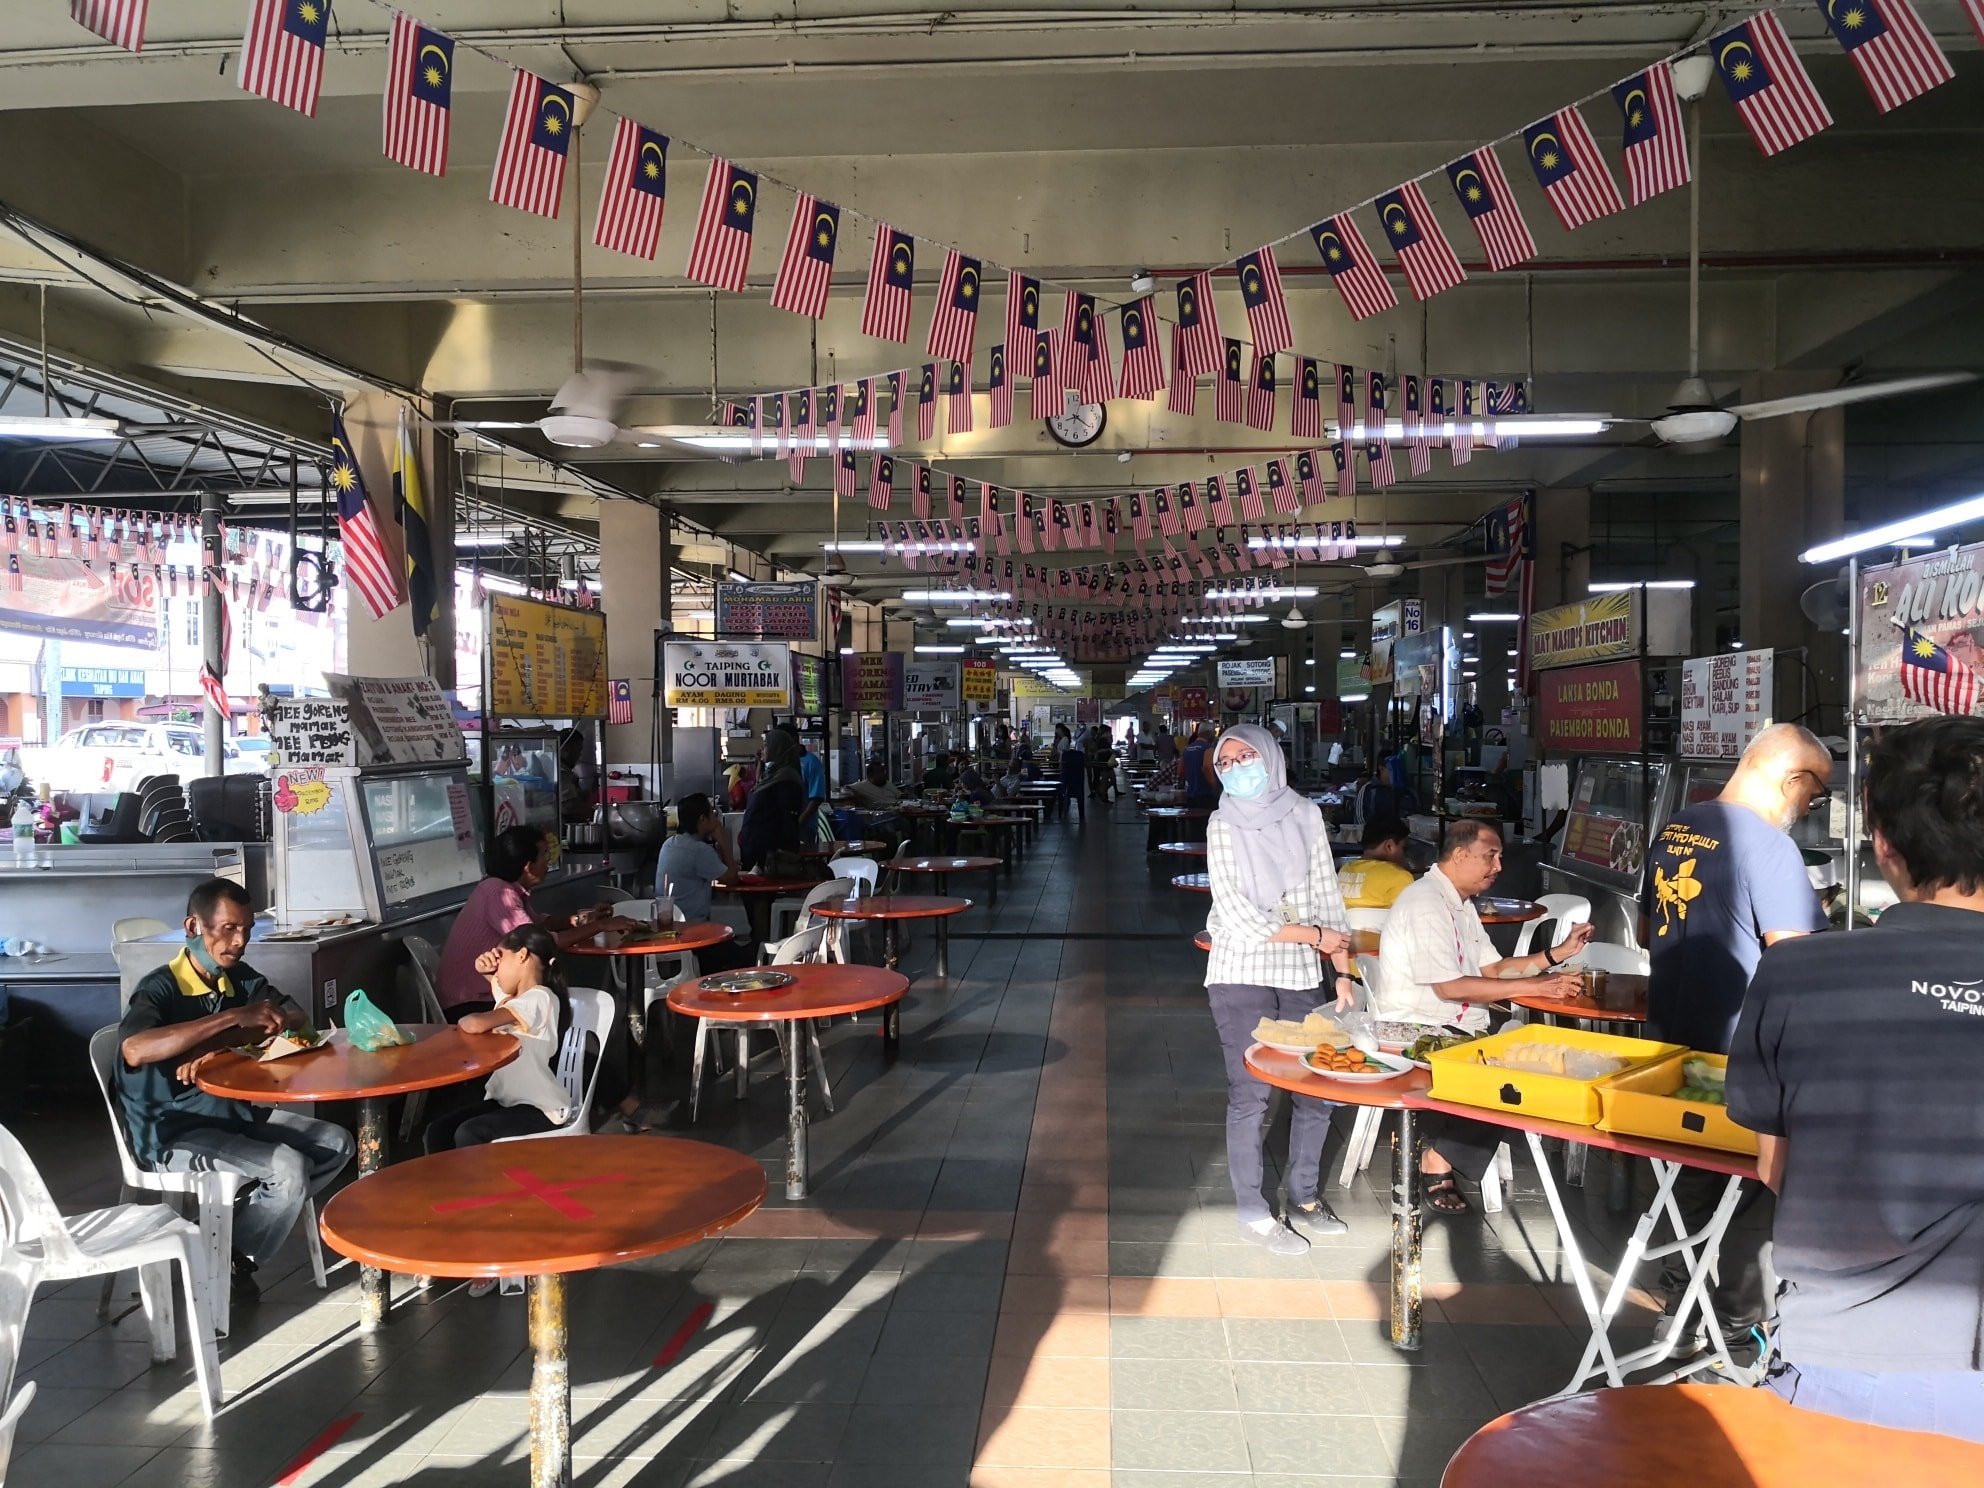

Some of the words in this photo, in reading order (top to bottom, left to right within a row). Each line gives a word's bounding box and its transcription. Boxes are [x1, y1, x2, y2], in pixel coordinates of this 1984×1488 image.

[1072, 394, 1080, 402] 12
[1057, 422, 1063, 430] 8
[1064, 429, 1069, 437] 7
[1072, 432, 1079, 440] 6
[1083, 429, 1088, 437] 5
[1871, 581, 1889, 605] 12
[1894, 579, 1937, 624] ALI
[1940, 570, 1984, 619] KO
[1405, 608, 1420, 618] No
[1405, 620, 1419, 630] 16
[1534, 633, 1550, 655] MAT
[1585, 617, 1628, 647] KITCHEN
[705, 662, 750, 671] TAIPING
[859, 657, 883, 665] MEE
[1712, 655, 1737, 669] GORENG
[853, 668, 896, 677] GORENG
[675, 673, 717, 687] NOOR
[724, 673, 780, 687] MURTABAK
[853, 680, 895, 688] MAMAK
[1712, 678, 1739, 691] BANDUNG
[1558, 683, 1583, 703] LAKSA
[1586, 680, 1619, 701] BONDA
[1550, 719, 1593, 737] PASEMBOR
[1596, 718, 1630, 738] BONDA
[1682, 721, 1694, 731] NASI
[1697, 720, 1711, 731] AYAM
[1682, 733, 1694, 743] NASI
[1699, 732, 1719, 743] ORENG
[1721, 733, 1737, 743] AYAM
[1682, 744, 1694, 755] NASI
[1696, 744, 1719, 755] GORENG
[288, 767, 326, 785] NEW!
[1911, 980, 1984, 1003] NOVO
